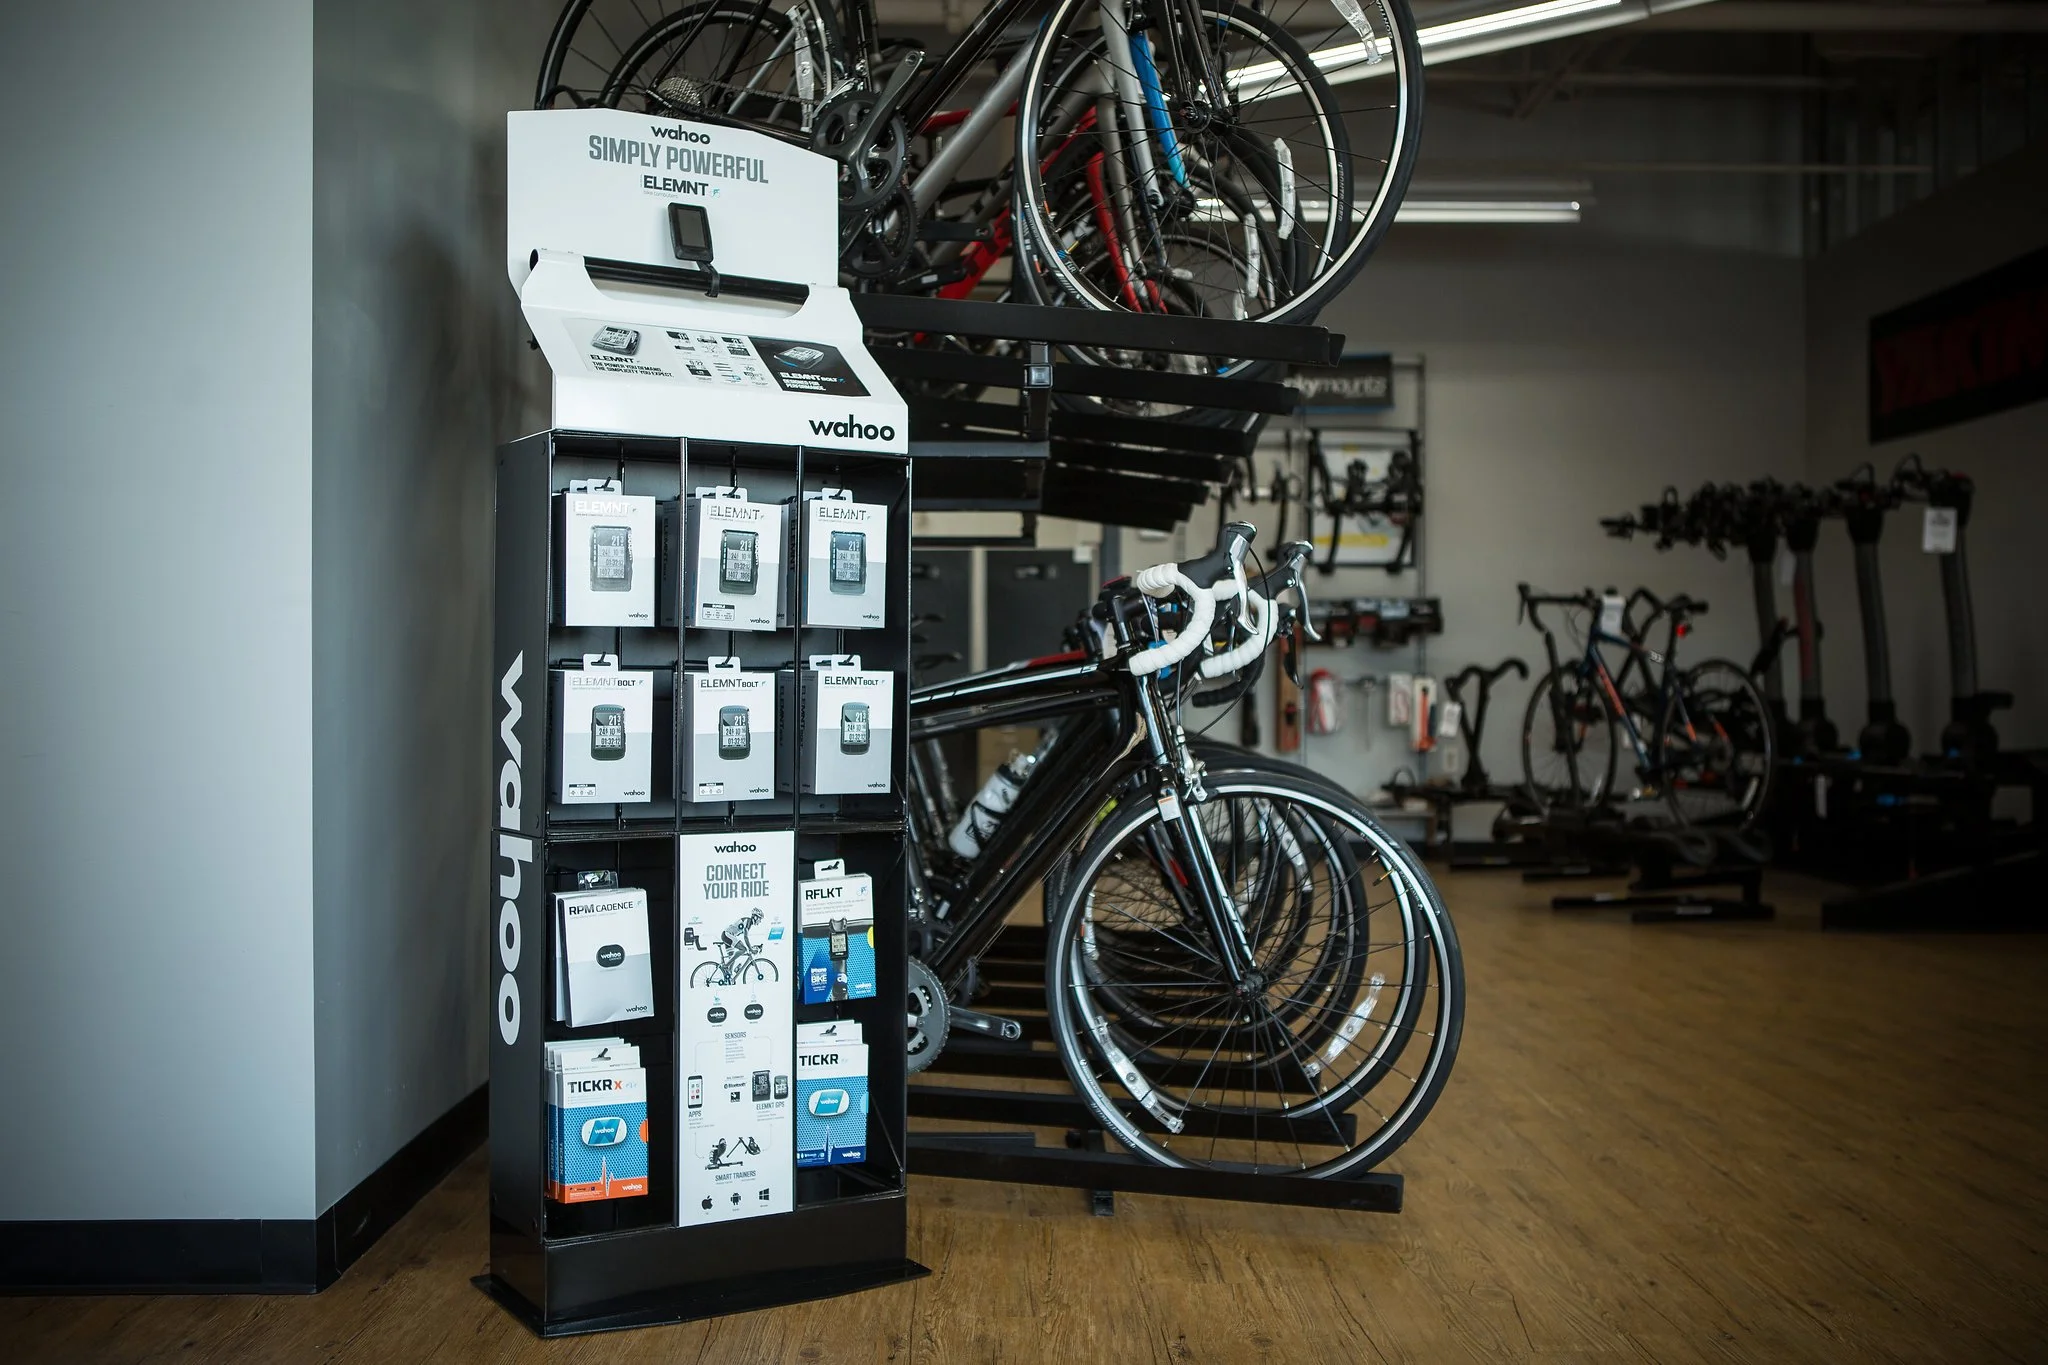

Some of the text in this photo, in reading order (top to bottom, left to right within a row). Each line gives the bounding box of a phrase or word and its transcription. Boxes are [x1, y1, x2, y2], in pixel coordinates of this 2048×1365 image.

[651, 124, 711, 144] wahoo
[588, 135, 769, 184] SIMPLY POWERFUL
[644, 174, 709, 196] ELEMNT
[808, 414, 896, 442] wahoo
[574, 500, 631, 515] ELEMNT
[710, 505, 761, 520] ELEMNT
[818, 506, 867, 521] ELEMNT
[700, 678, 742, 688] ELEMNT
[824, 676, 864, 686] ELEMNT
[498, 649, 533, 1046] wahoo
[714, 841, 757, 854] wahoo
[706, 862, 767, 882] CONNECT
[703, 880, 770, 900] YOUR RIDE
[805, 886, 843, 900] RFLKT
[568, 904, 594, 916] RPM
[596, 901, 634, 913] CADENCE
[600, 952, 622, 960] wahoo
[626, 1004, 648, 1013] wahoo
[724, 1032, 747, 1040] SENSORS
[798, 1053, 839, 1066] TICKR
[567, 1078, 622, 1094] TICKR X
[756, 1102, 774, 1110] ELEMNT
[688, 1110, 702, 1118] APPS
[594, 1126, 615, 1134] wahoo
[842, 1150, 862, 1158] wahoo
[715, 1173, 732, 1182] SMART
[733, 1170, 756, 1180] TRAINERS
[622, 1182, 643, 1191] wahoo
